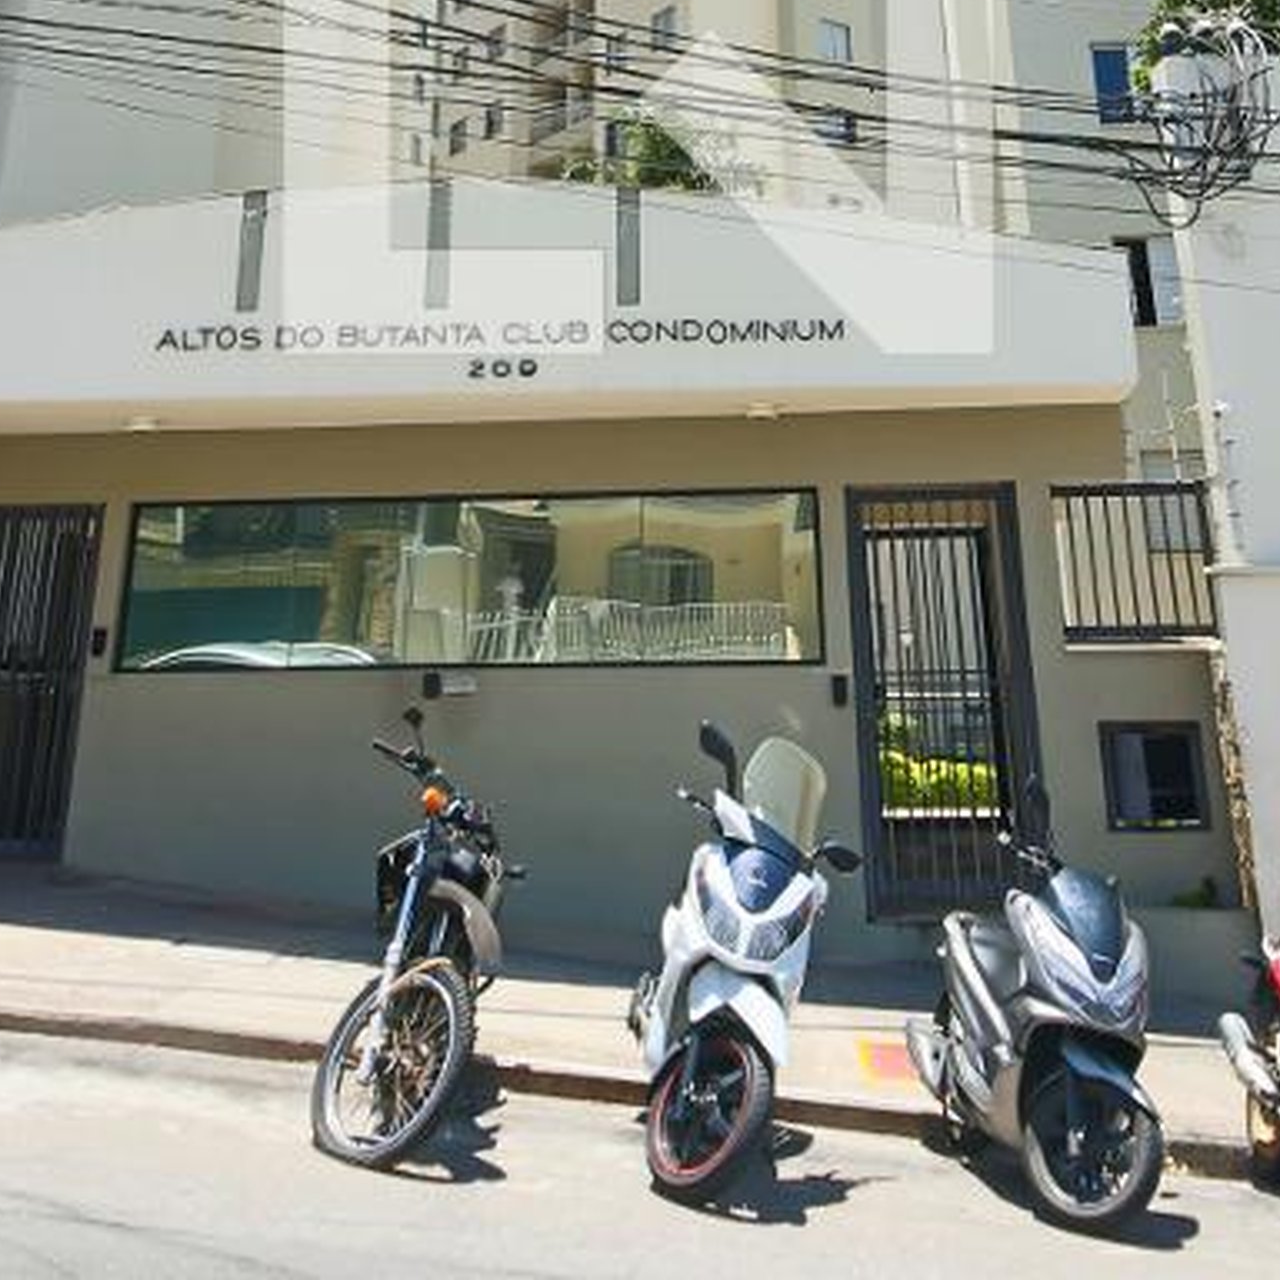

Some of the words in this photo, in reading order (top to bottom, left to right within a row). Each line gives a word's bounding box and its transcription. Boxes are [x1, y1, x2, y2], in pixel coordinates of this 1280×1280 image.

[155, 326, 261, 351] ALTOS
[275, 325, 324, 349] DO
[502, 321, 589, 344] CLUB
[607, 319, 846, 344] CONDOMINIUM
